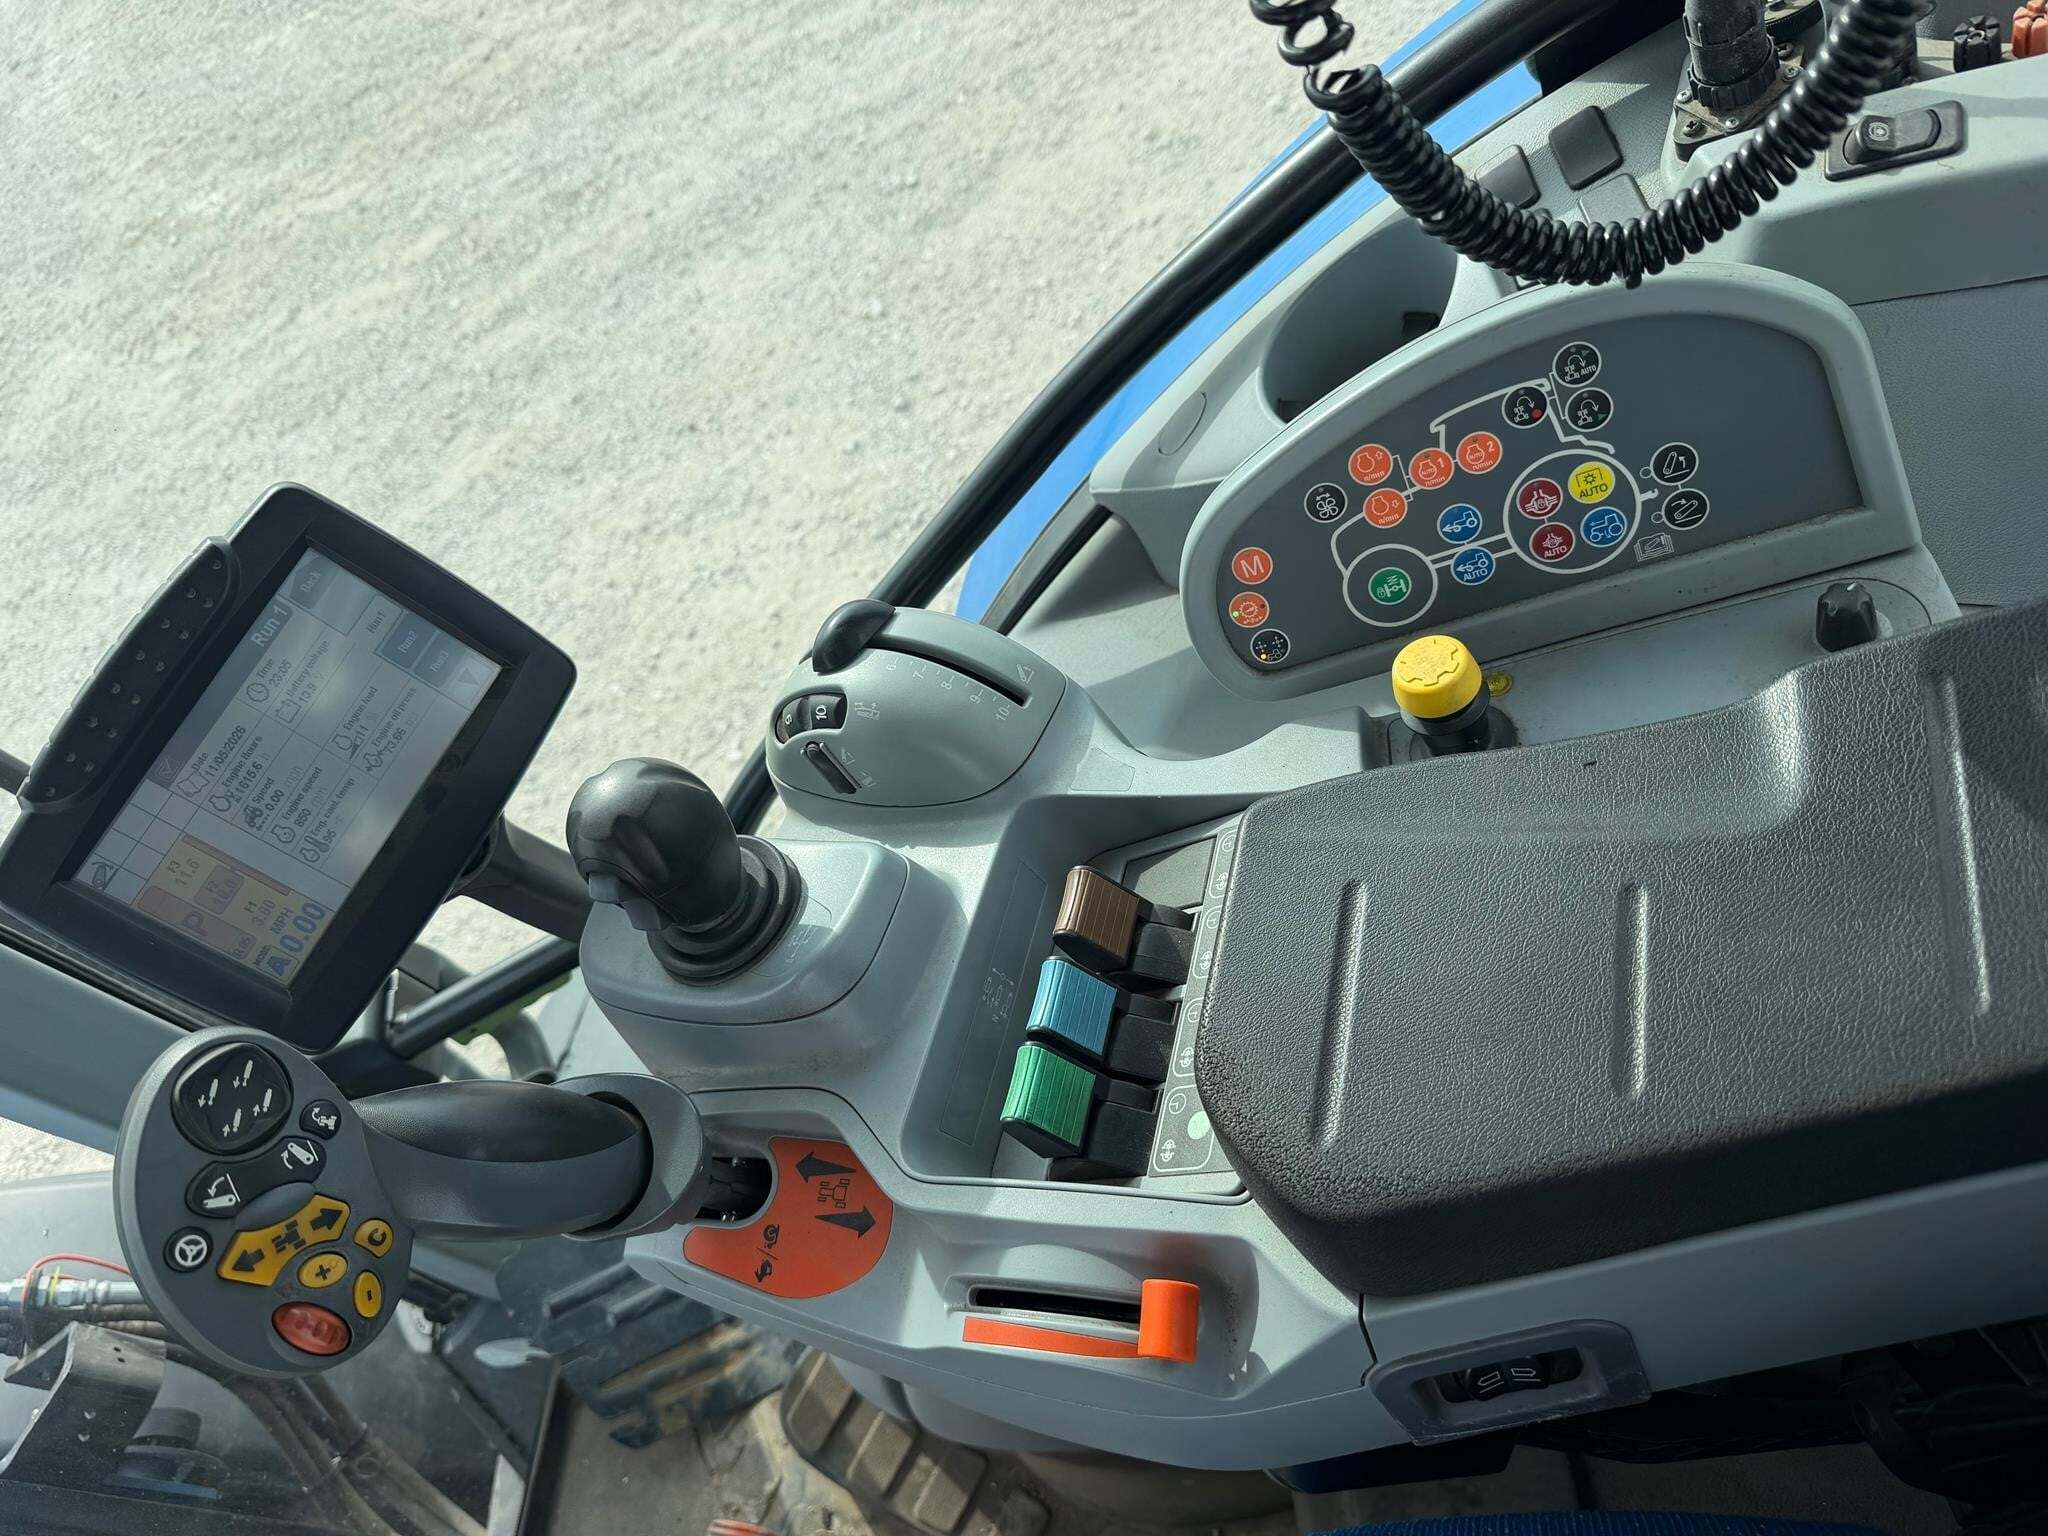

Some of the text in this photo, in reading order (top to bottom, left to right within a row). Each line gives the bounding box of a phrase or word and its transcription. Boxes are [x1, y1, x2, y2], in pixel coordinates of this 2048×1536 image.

[1580, 364, 1598, 376] AUTO
[1486, 441, 1495, 452] 2
[1437, 457, 1445, 468] 1
[1472, 460, 1494, 471] n/min
[1363, 470, 1386, 482] n/min
[1425, 476, 1446, 487] n/min
[1579, 483, 1608, 499] AUTO
[1378, 513, 1400, 525] n/min
[1544, 545, 1568, 558] AUTO
[1240, 555, 1265, 578] M
[1463, 568, 1488, 581] AUTO
[251, 604, 287, 646] Run 1
[886, 663, 897, 671] 6
[912, 670, 924, 680] 7
[941, 680, 952, 690] 8
[969, 693, 980, 703] 9
[815, 704, 828, 720] 10
[994, 705, 1010, 721] 10
[191, 751, 208, 770] Date
[221, 734, 262, 787] Engine Hours
[252, 777, 275, 804] Speed
[282, 766, 324, 820] Engine speed
[264, 789, 285, 811] 0.00
[182, 910, 212, 934] P
[269, 907, 293, 933] MPH
[266, 902, 325, 974] A 0.00
